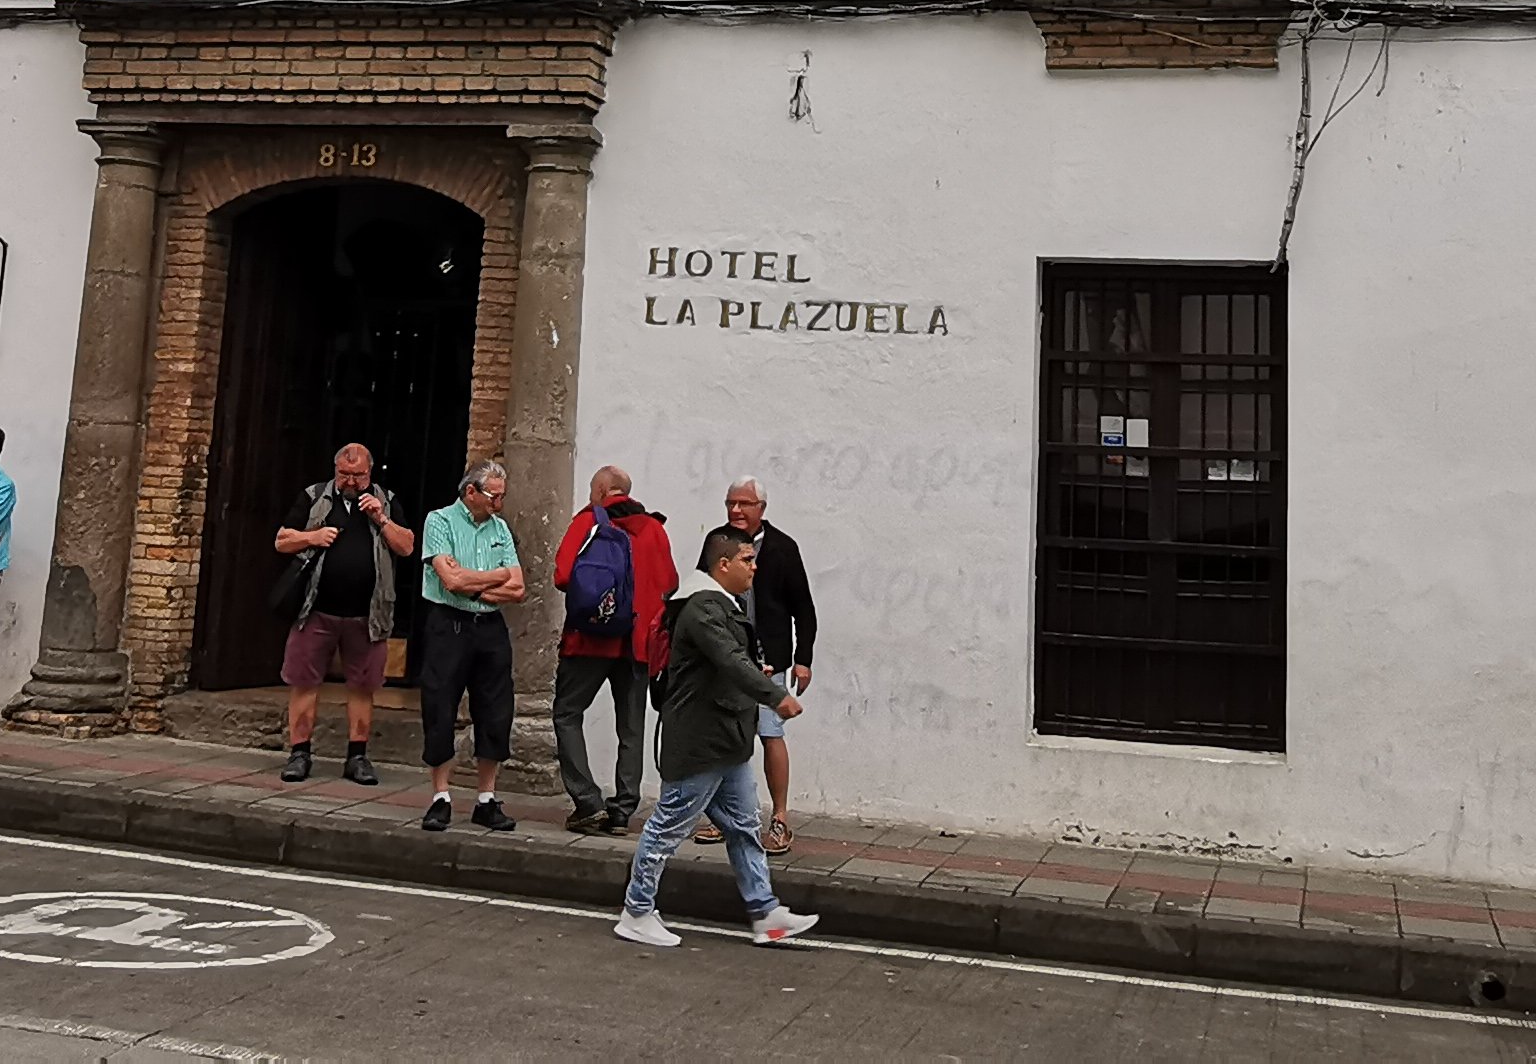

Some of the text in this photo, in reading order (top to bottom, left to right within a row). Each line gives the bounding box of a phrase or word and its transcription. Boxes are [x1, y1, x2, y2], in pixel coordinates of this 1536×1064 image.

[318, 143, 377, 167] 8-13
[647, 246, 811, 283] HOTEL
[644, 296, 949, 336] LA PLAZUELA
